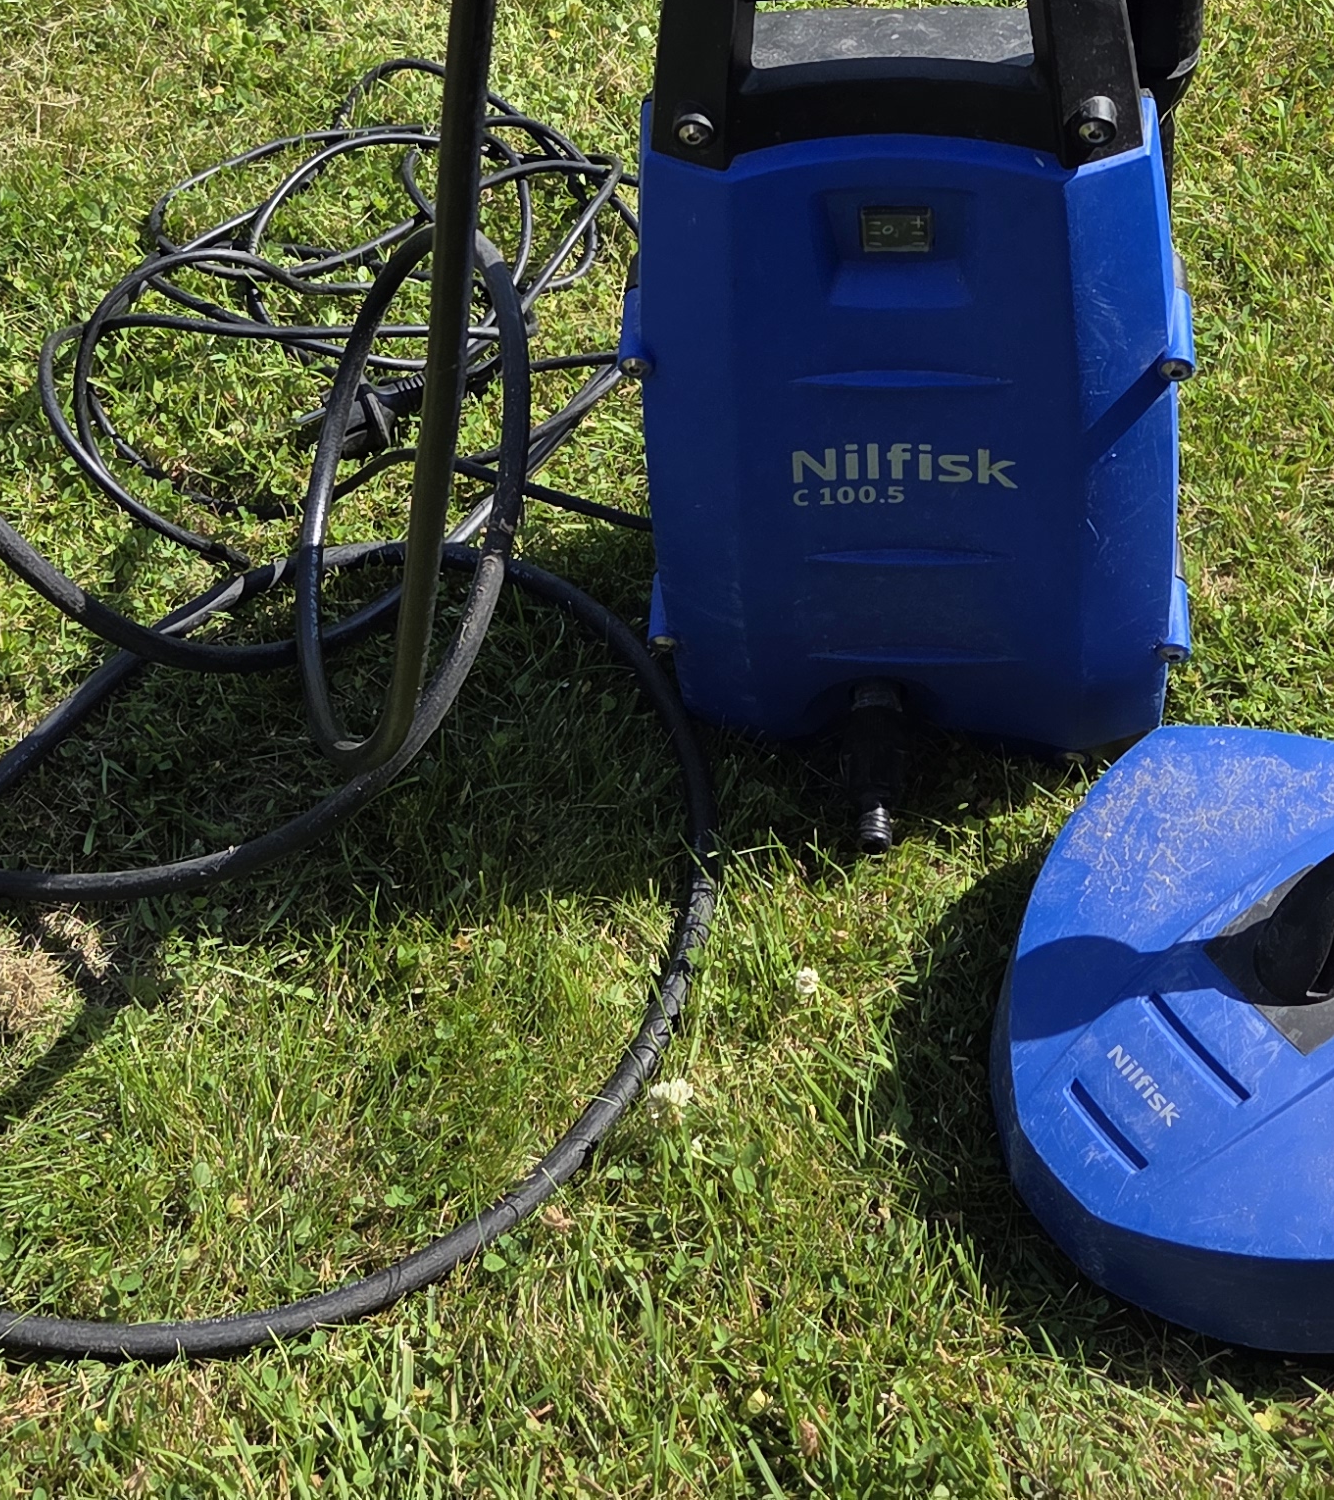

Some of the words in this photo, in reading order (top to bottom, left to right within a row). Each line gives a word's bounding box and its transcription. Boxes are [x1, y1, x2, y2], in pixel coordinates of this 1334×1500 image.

[792, 443, 1018, 489] Nilfisk
[793, 489, 809, 506] C
[819, 486, 905, 506] 100.5
[1106, 1044, 1181, 1128] Nilfisk
